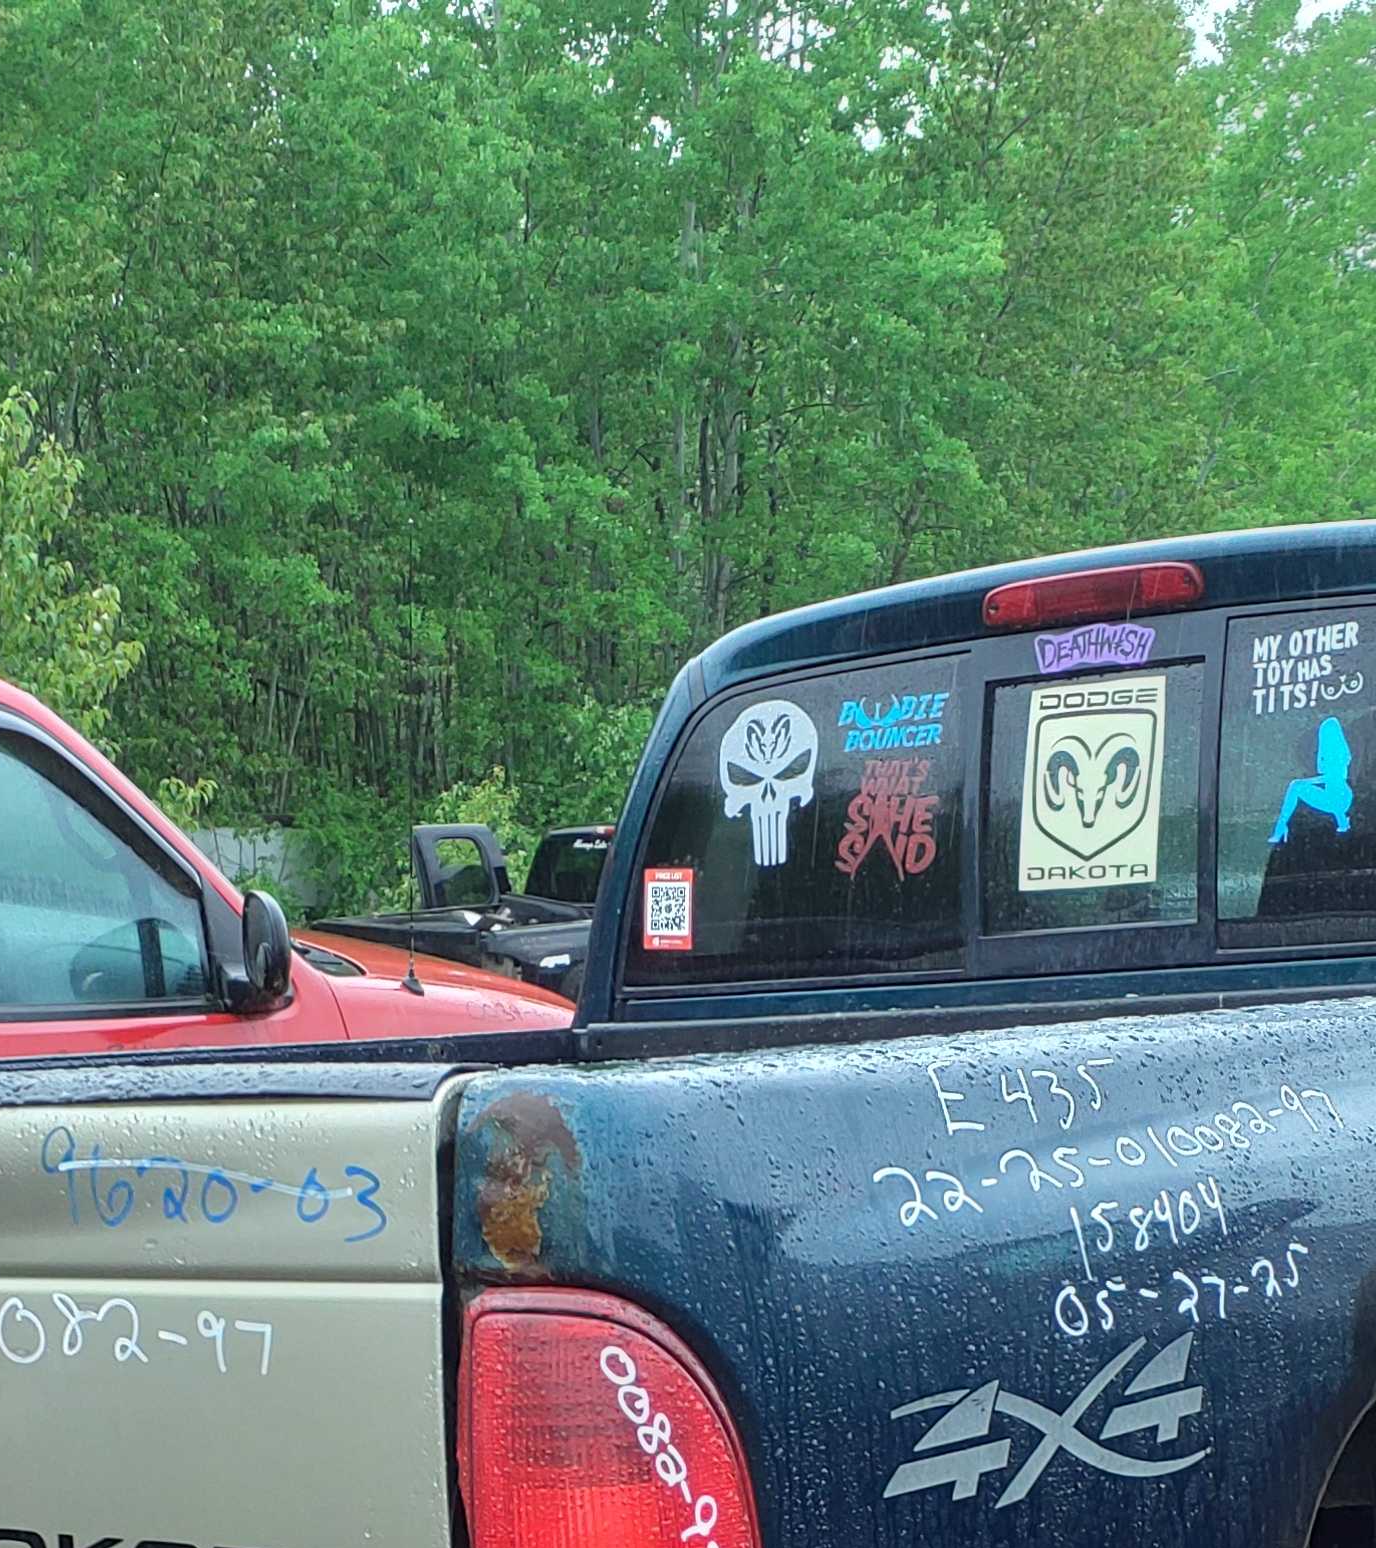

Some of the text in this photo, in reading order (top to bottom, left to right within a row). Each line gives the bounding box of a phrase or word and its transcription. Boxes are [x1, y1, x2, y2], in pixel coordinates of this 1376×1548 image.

[1253, 621, 1359, 663] MY OTHER
[1253, 654, 1332, 687] TOY HAS
[1039, 688, 1158, 710] DODGE
[1252, 681, 1319, 715] TITS!
[844, 723, 943, 752] BOUNCER
[864, 756, 929, 778] THAT'S
[843, 793, 940, 834] SHE
[1027, 864, 1148, 880] DAKOTA
[927, 1057, 1114, 1136] E 435
[42, 1126, 387, 1243] 9620-03
[1070, 1176, 1228, 1280] 158404
